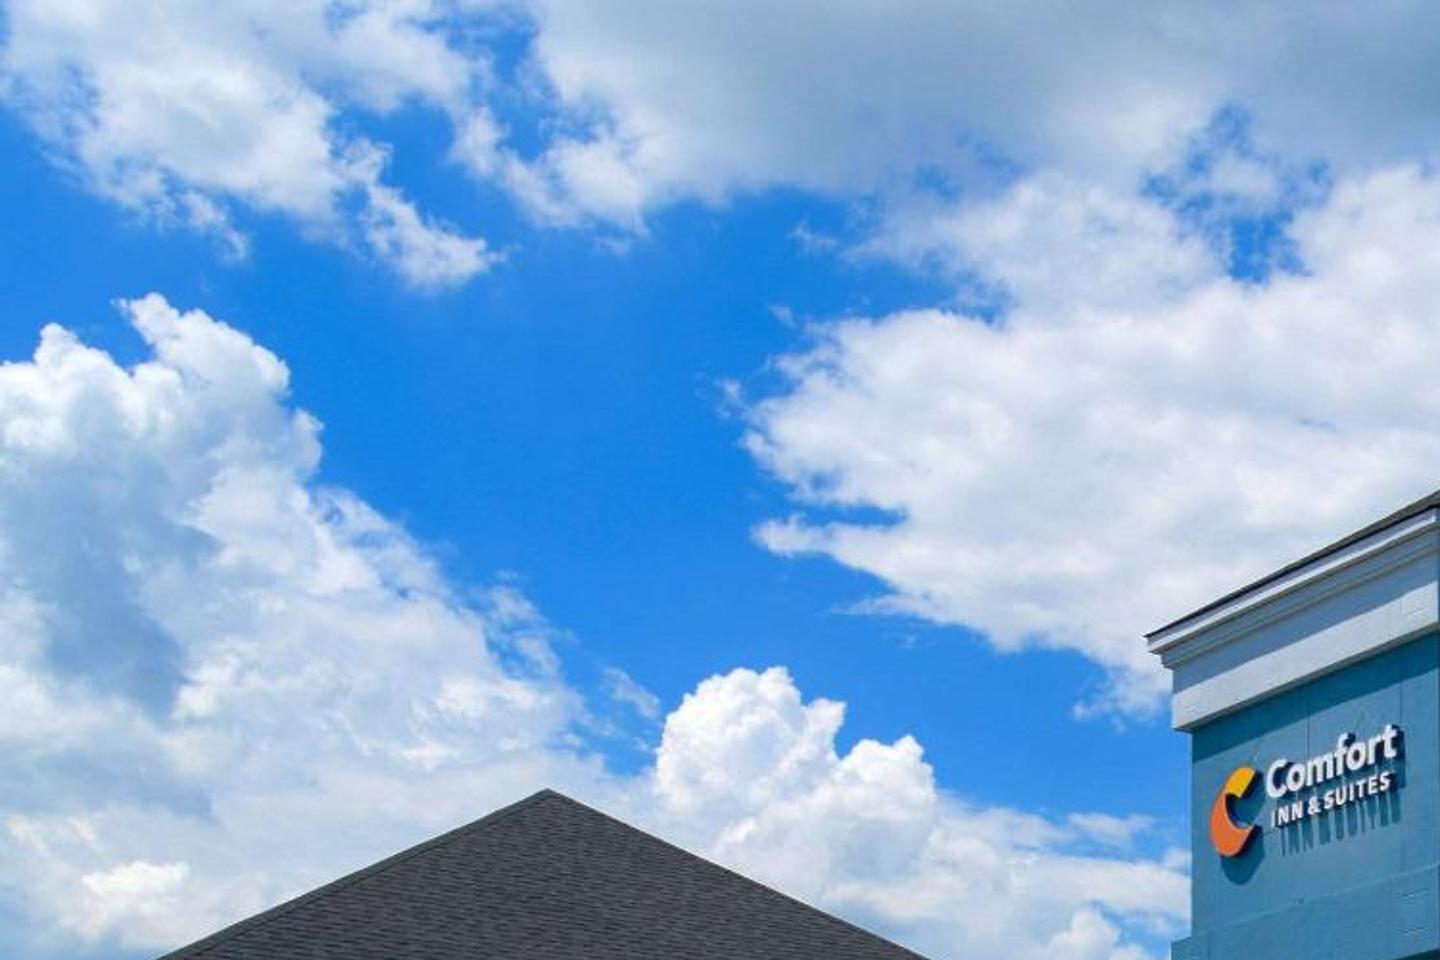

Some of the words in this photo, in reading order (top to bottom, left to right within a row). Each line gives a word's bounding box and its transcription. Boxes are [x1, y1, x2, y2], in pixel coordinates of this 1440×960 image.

[1266, 724, 1398, 798] Comfort
[1270, 801, 1304, 828] INN
[1307, 796, 1321, 815] &
[1324, 771, 1393, 809] SUITES
